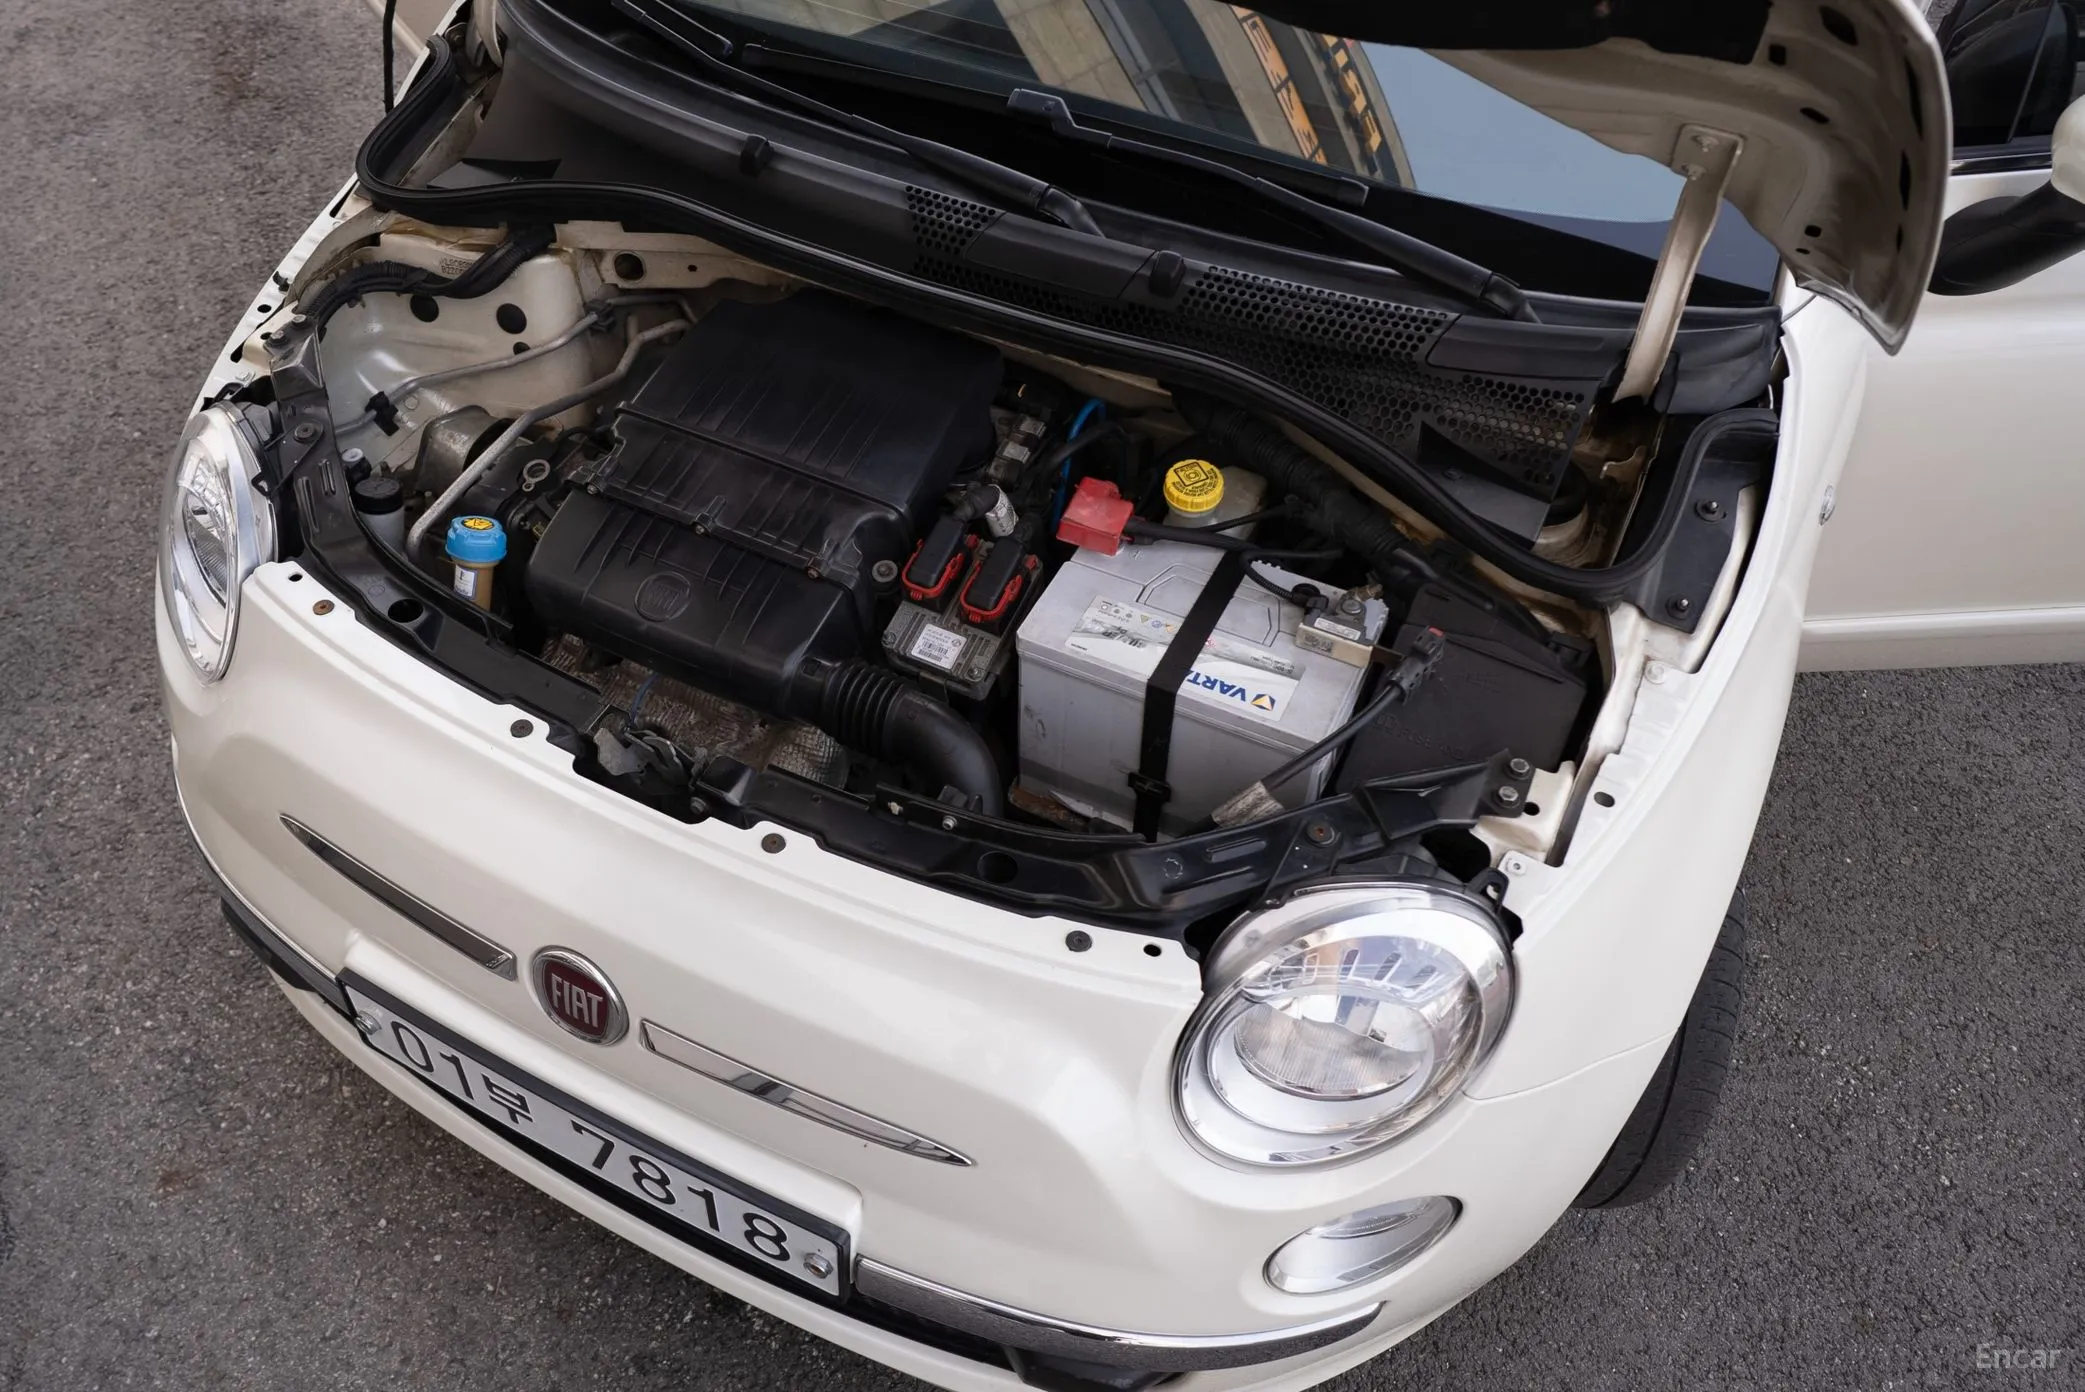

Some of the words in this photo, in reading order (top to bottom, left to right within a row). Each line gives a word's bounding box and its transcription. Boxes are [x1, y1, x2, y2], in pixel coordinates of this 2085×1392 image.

[551, 973, 604, 1028] FIAT
[390, 1020, 534, 1124] 01부
[571, 1119, 790, 1261] 7818
